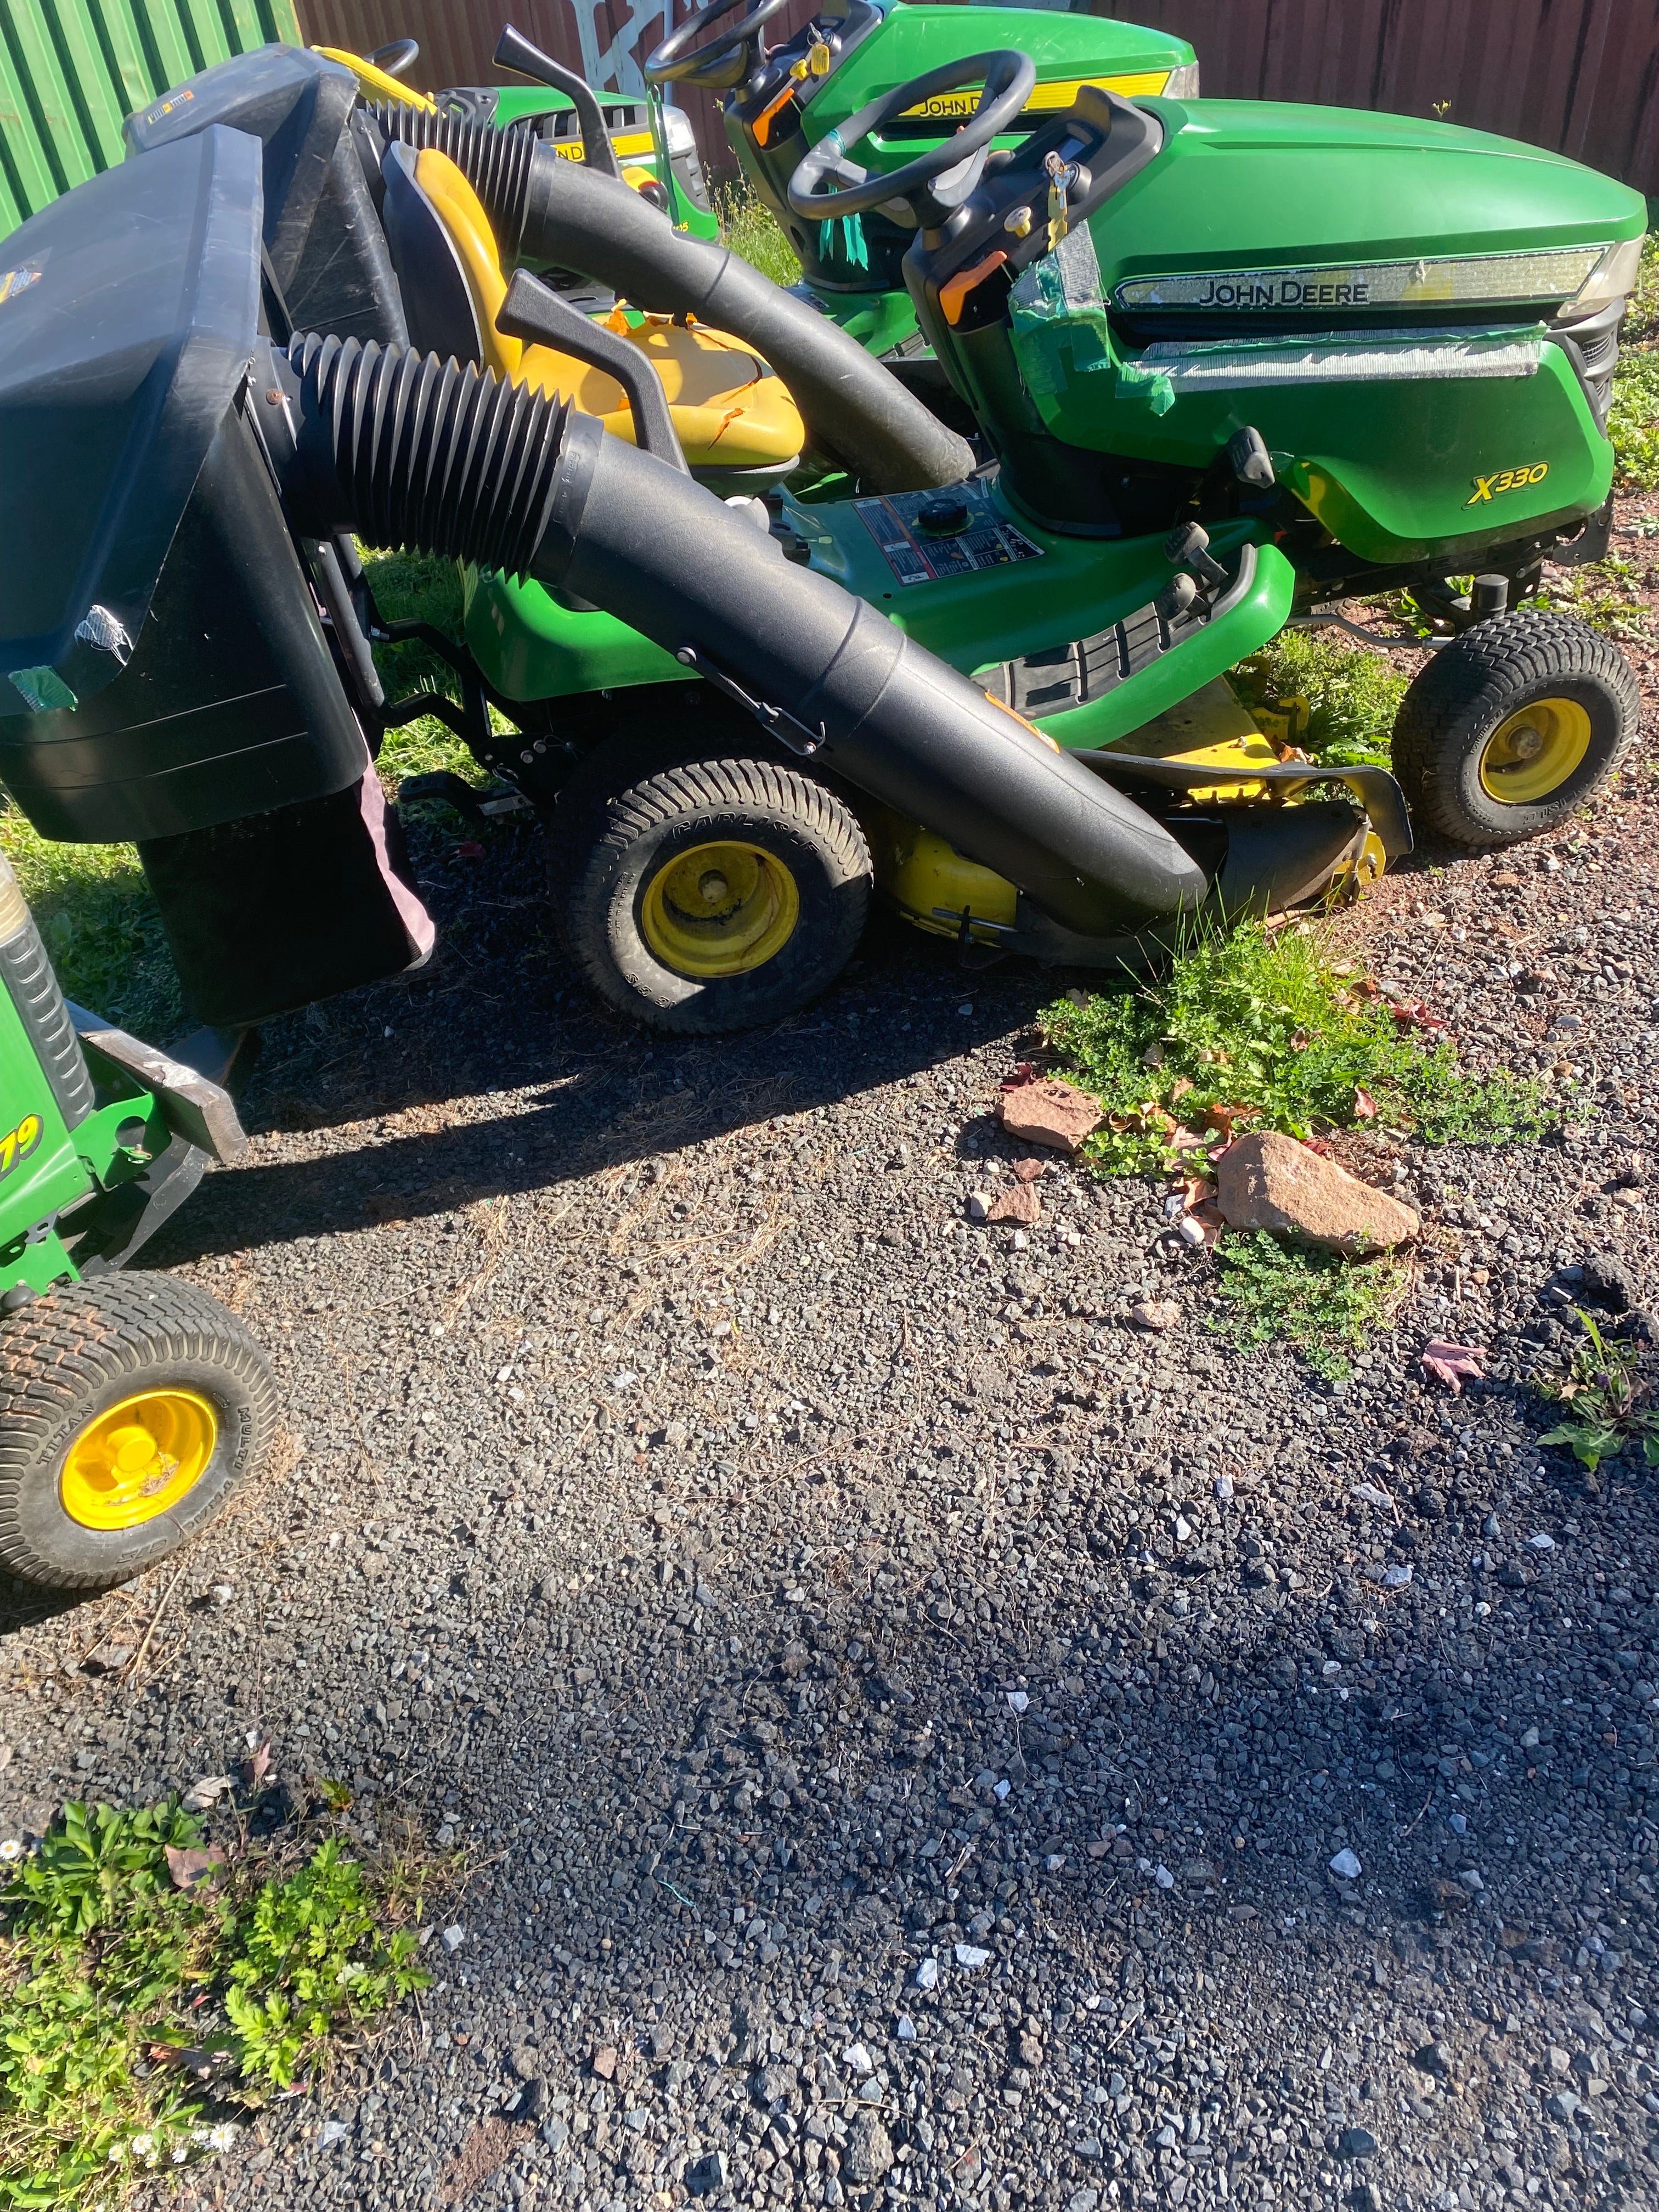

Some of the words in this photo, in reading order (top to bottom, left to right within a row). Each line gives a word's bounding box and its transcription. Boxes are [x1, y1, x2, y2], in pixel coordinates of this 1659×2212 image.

[919, 100, 967, 115] JOHN
[1199, 280, 1274, 303] JOHN
[1281, 280, 1369, 303] DEERE
[1466, 462, 1549, 505] X330
[36, 1401, 95, 1465] TITAN
[233, 1407, 252, 1470] MULTI
